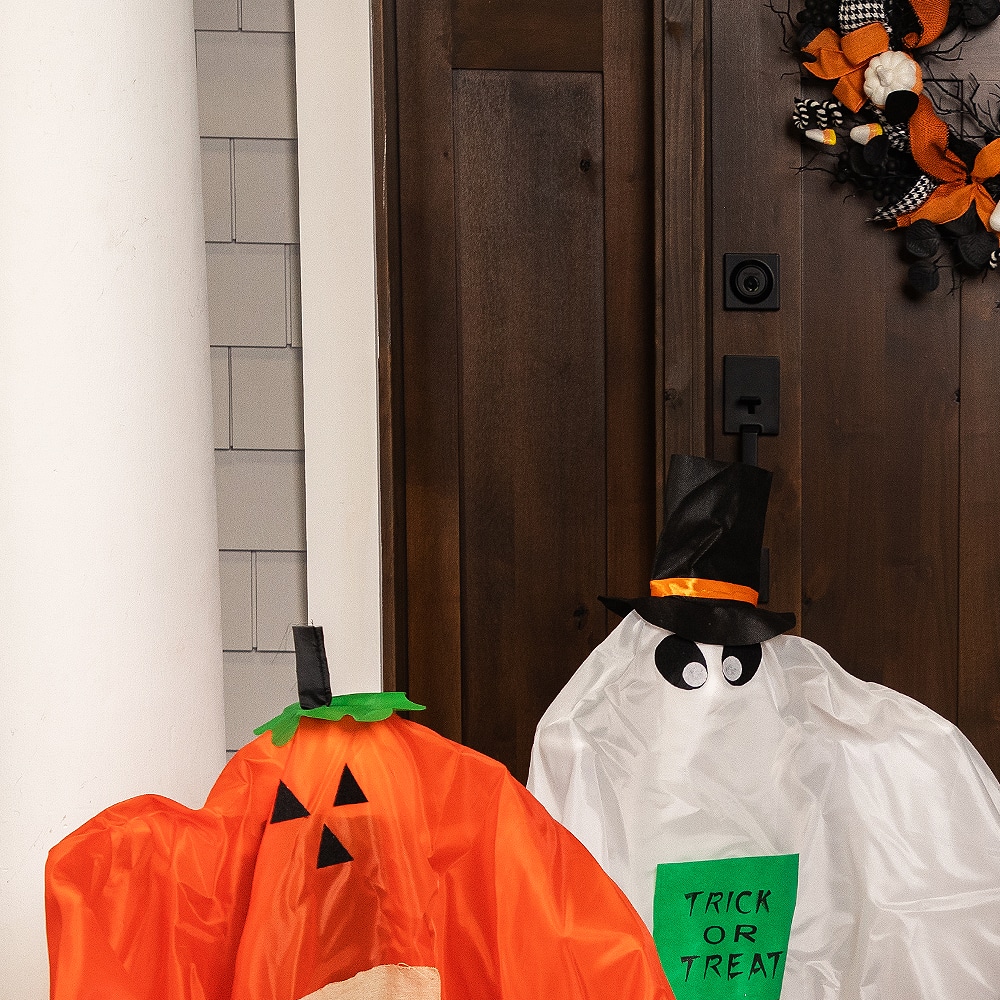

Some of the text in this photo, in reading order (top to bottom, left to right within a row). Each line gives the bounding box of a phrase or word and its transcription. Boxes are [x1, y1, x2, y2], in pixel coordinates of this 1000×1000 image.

[684, 889, 772, 917] TRICK
[703, 924, 758, 945] OR
[680, 950, 784, 982] TREAT
